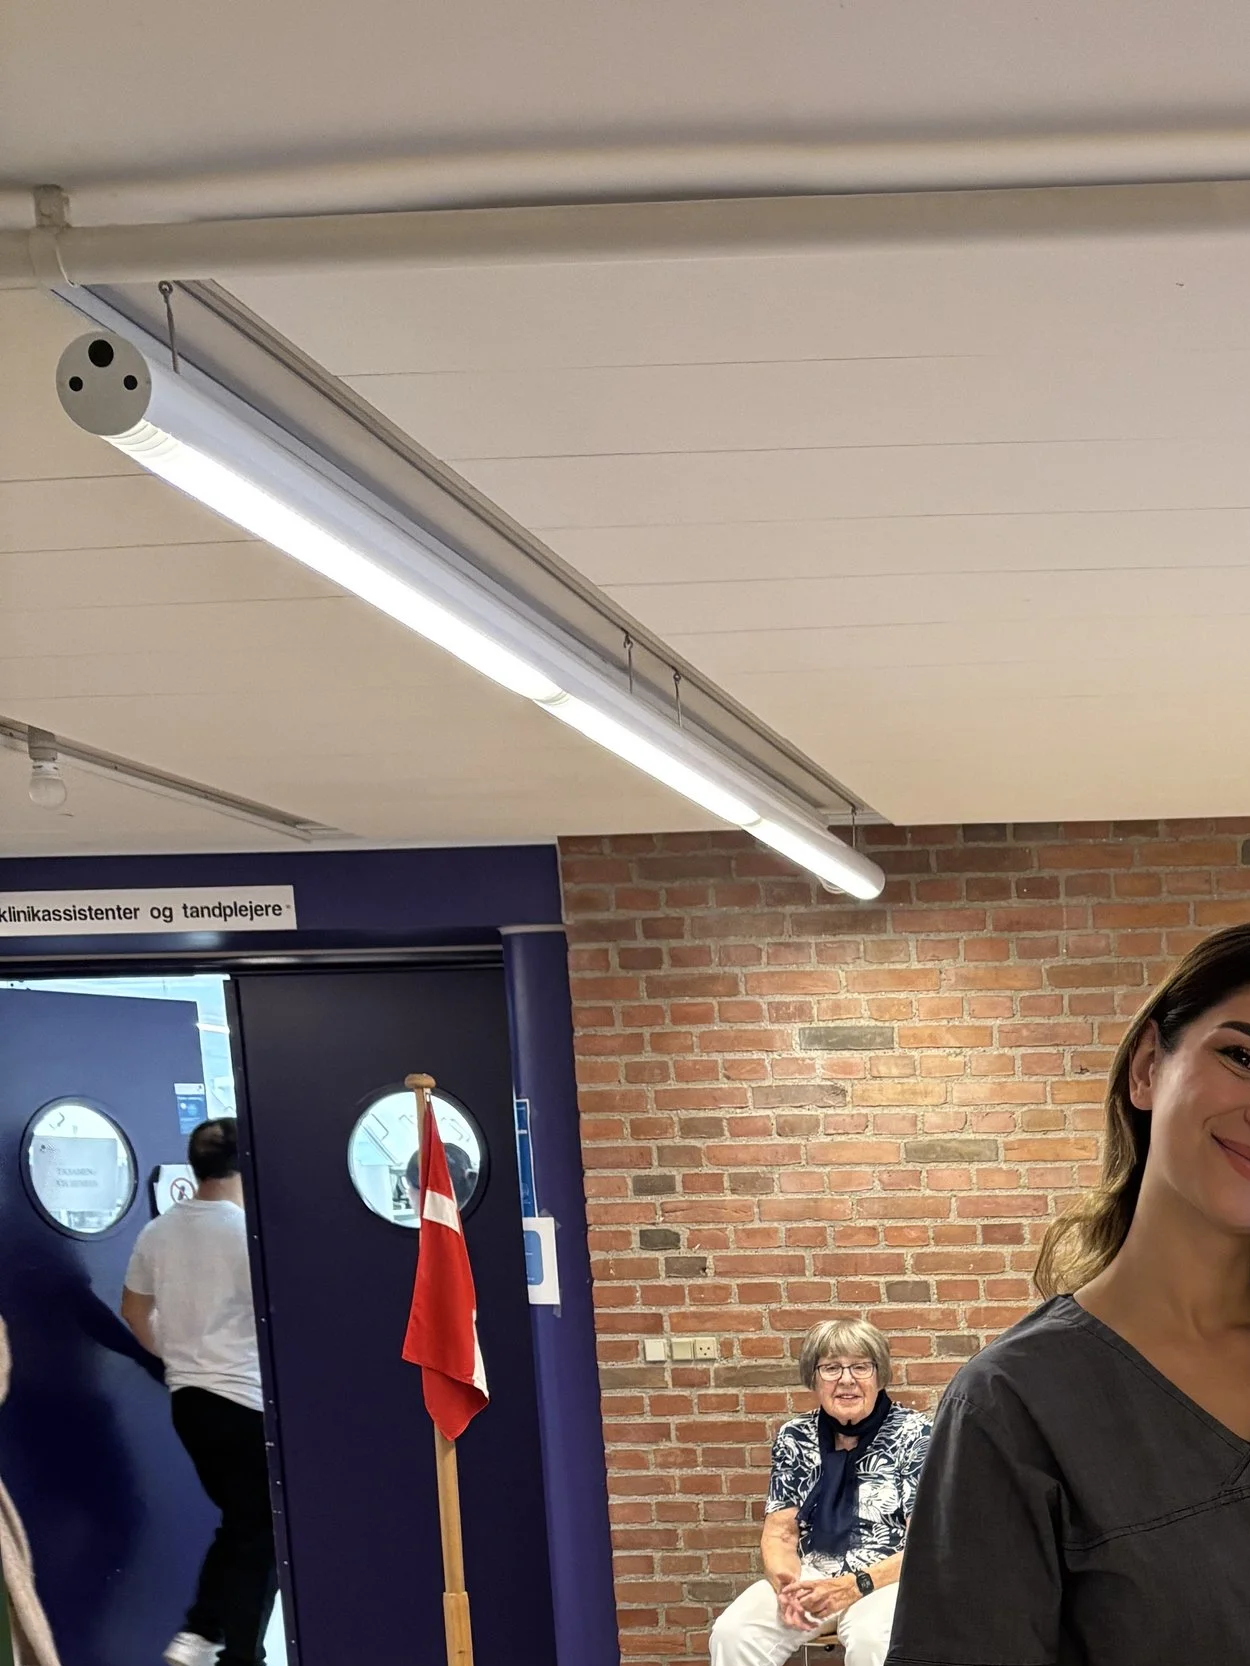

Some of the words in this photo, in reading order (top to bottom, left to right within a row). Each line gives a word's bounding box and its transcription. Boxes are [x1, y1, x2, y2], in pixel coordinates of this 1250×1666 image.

[0, 905, 140, 923] klinikassistenter
[149, 905, 174, 922] og
[182, 901, 283, 922] tandplejere
